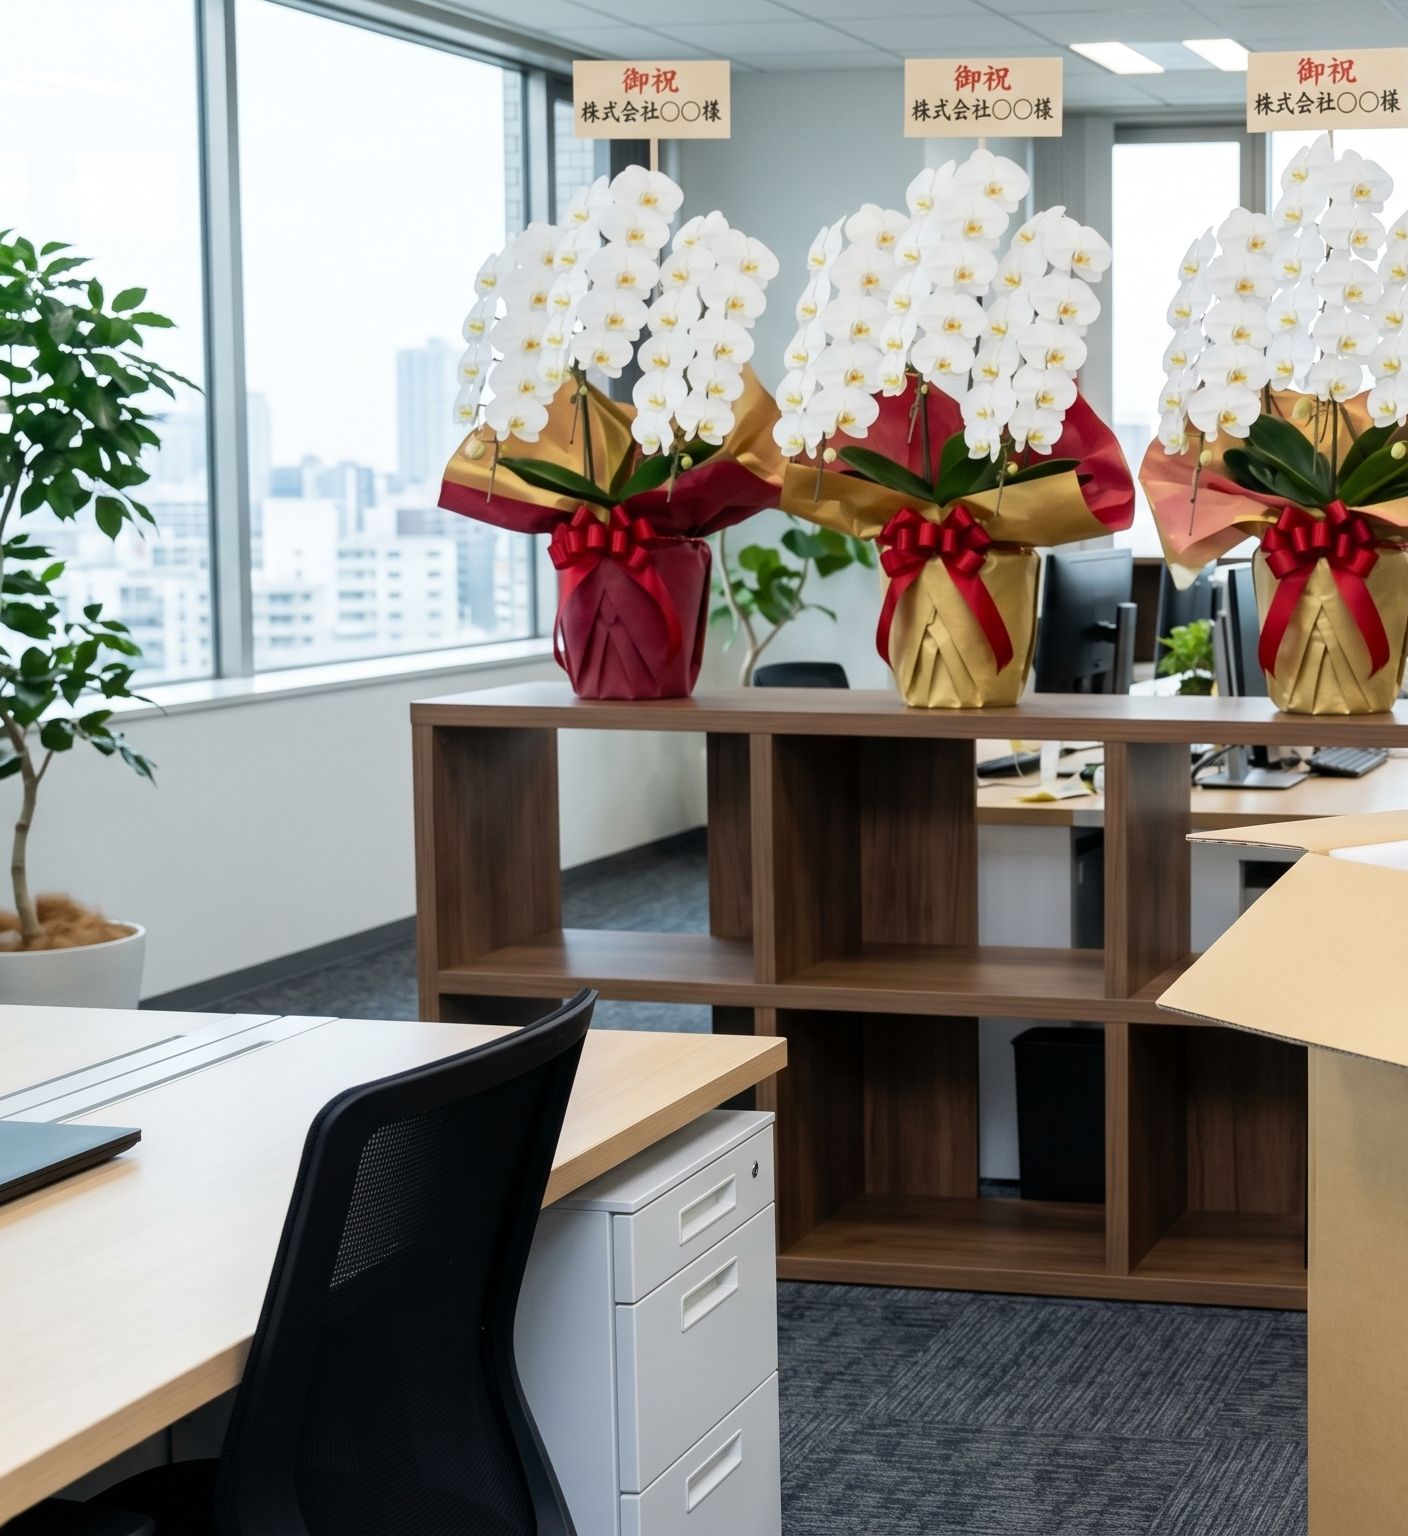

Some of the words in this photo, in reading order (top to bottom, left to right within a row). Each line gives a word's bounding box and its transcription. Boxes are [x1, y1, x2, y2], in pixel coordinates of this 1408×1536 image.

[622, 67, 680, 95] 御祝
[954, 64, 1012, 93] 御祝
[1297, 57, 1357, 86] 御祝
